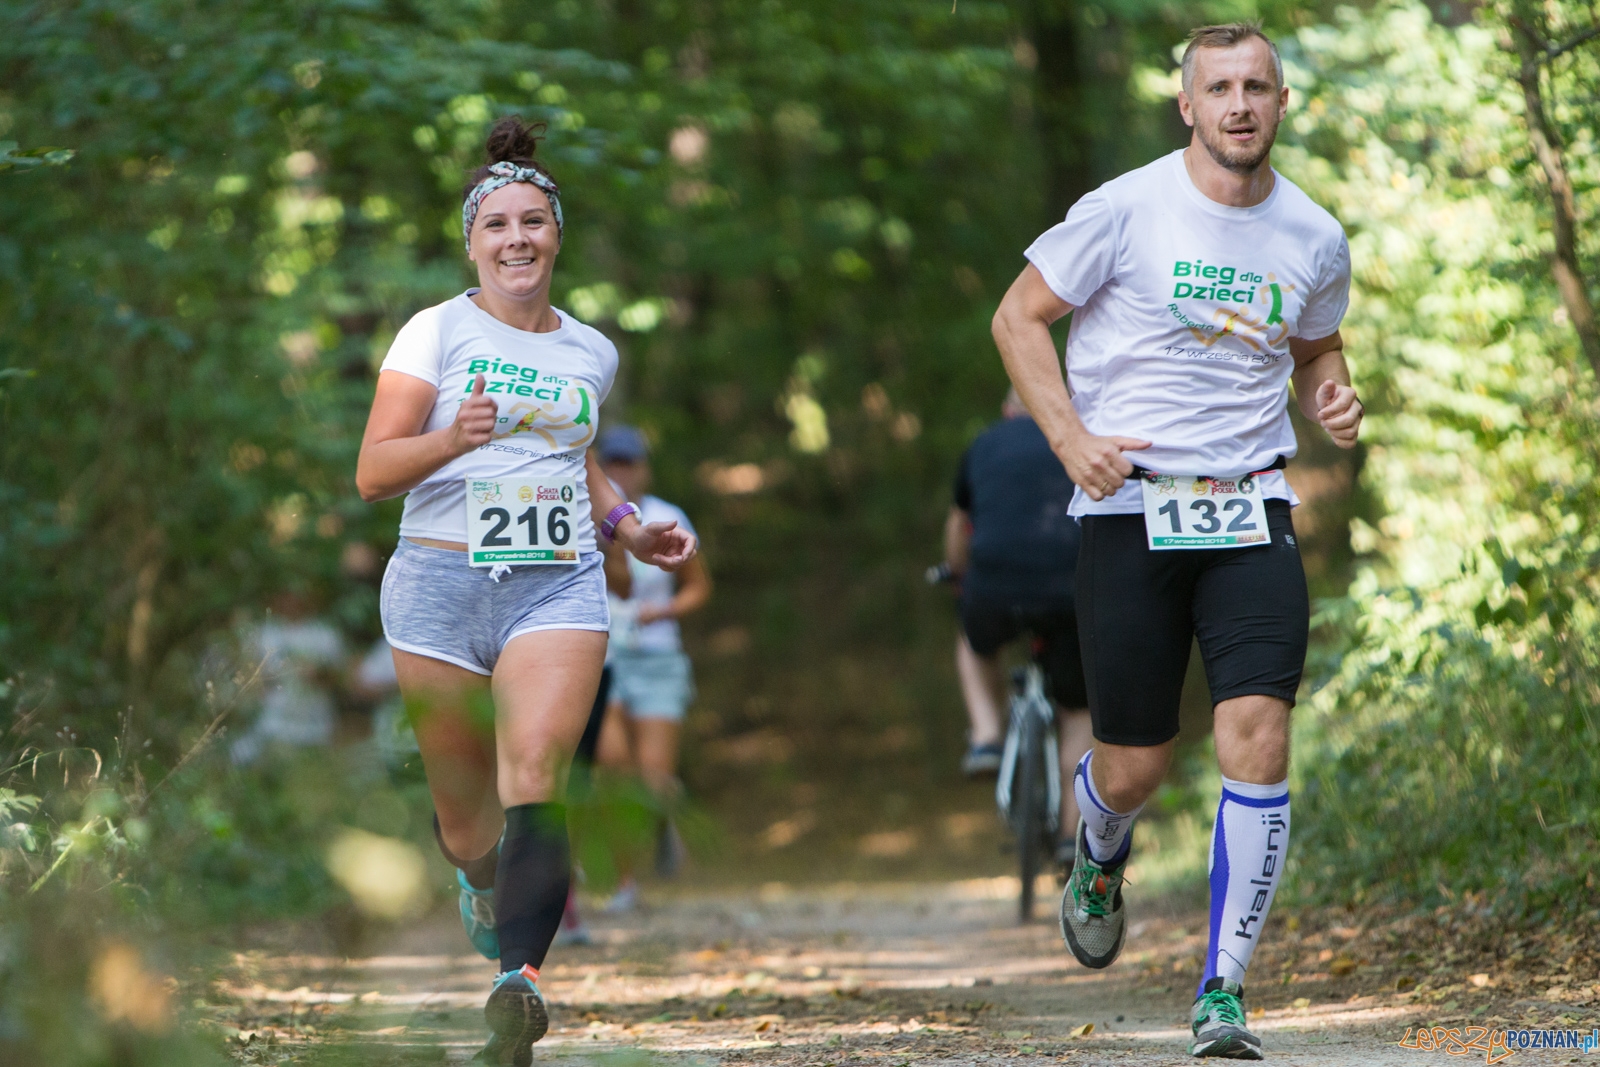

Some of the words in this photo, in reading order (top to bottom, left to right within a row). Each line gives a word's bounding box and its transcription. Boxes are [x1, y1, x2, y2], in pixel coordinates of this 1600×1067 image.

[1172, 259, 1237, 285] Bieg
[1239, 272, 1263, 283] dla
[1173, 282, 1256, 304] Dzieci
[1164, 346, 1185, 356] 17
[1187, 350, 1249, 363] września
[467, 357, 538, 383] Bieg
[542, 375, 569, 386] dla
[537, 485, 559, 495] CHATA
[1211, 487, 1238, 496] POLSKA
[1212, 478, 1236, 488] CHATA
[536, 494, 561, 503] POLSKA
[1158, 498, 1257, 534] 132
[480, 505, 571, 547] 216
